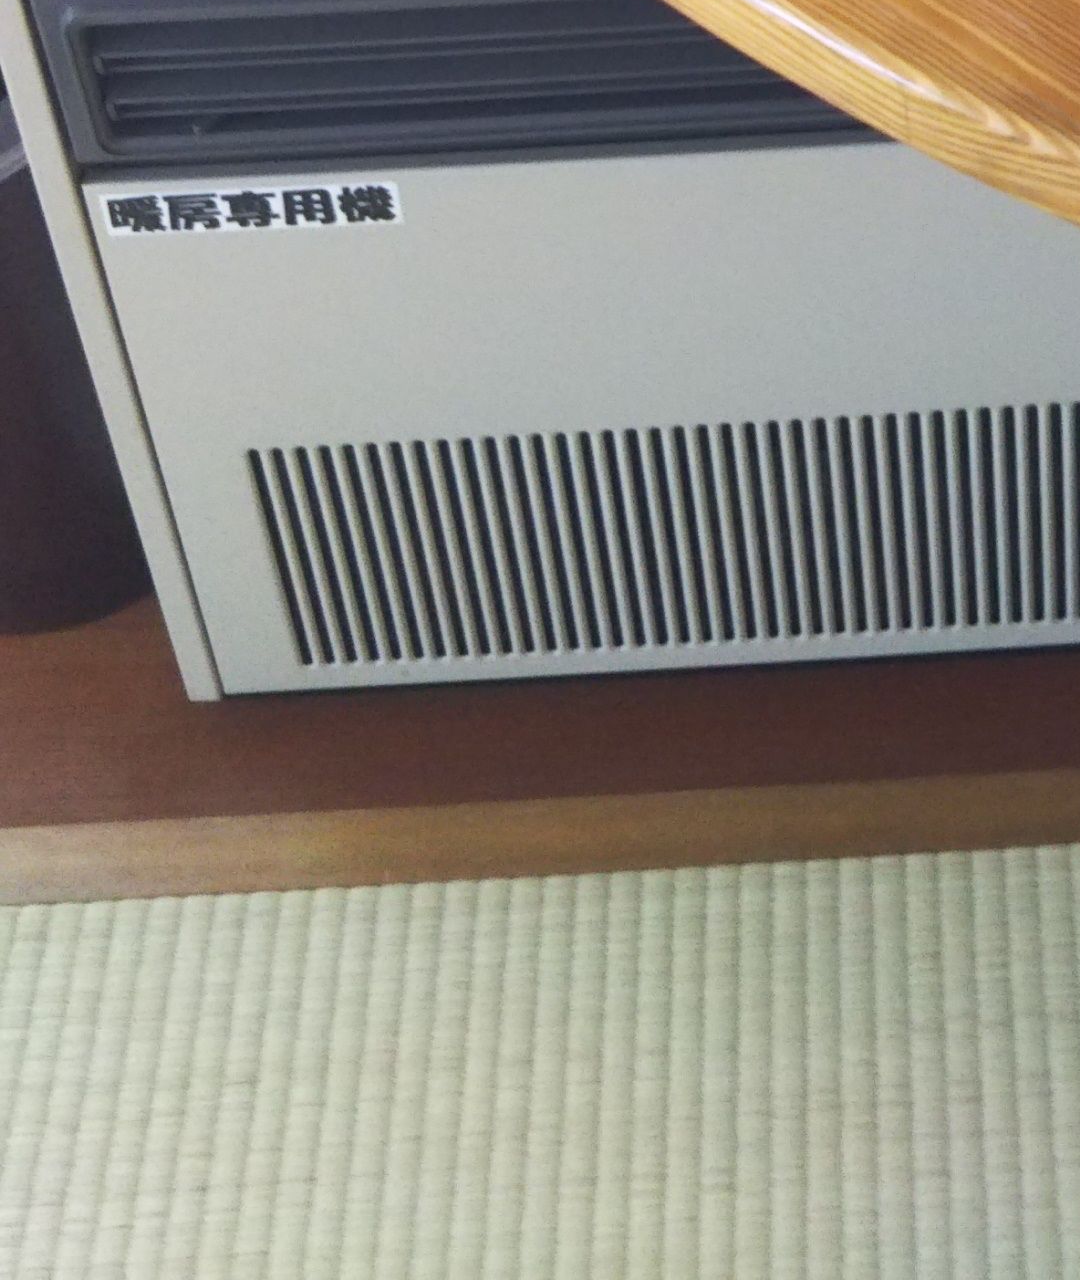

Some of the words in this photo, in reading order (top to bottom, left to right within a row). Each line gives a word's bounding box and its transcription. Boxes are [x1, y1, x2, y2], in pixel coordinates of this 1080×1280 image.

[107, 185, 397, 232] 暖房専用機
